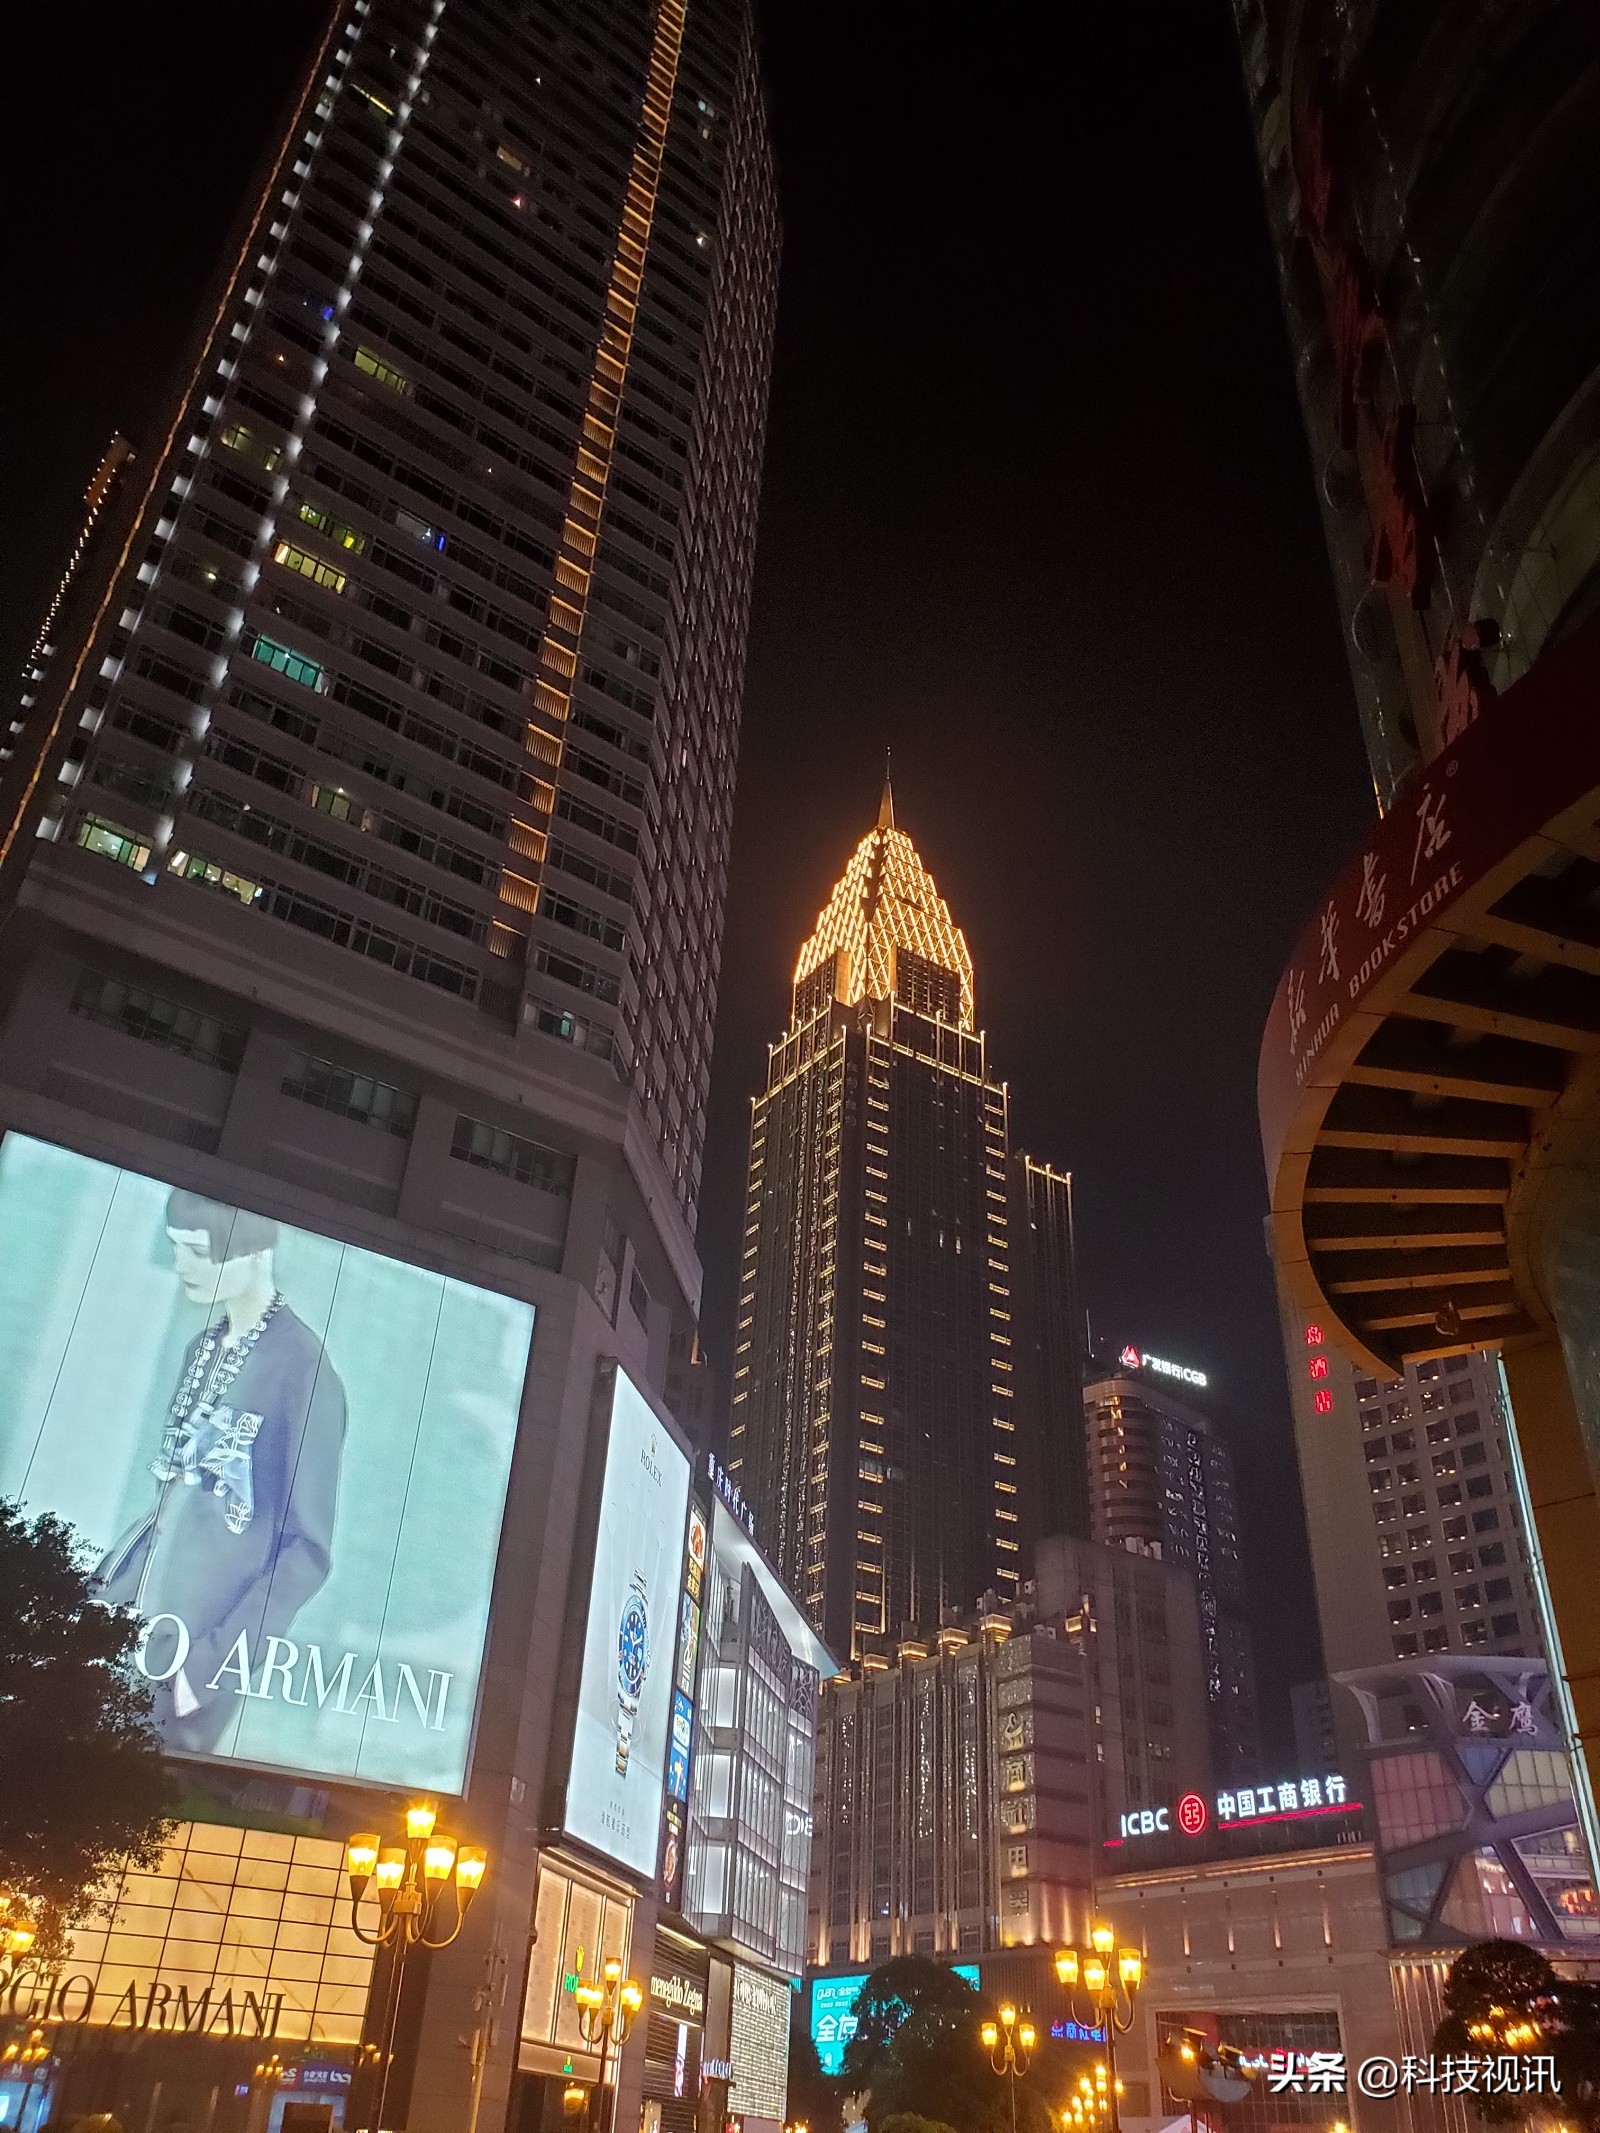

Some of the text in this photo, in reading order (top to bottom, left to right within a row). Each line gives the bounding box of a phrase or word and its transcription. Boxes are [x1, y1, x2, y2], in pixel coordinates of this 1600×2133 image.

[1295, 860, 1465, 1086] XINHUA BOOKSTORE
[640, 1448, 663, 1488] ROLEX
[205, 1628, 454, 1733] ARMANI
[1120, 1774, 1347, 1838] ICBC 中国工商银行
[106, 1978, 287, 2038] ARMANI
